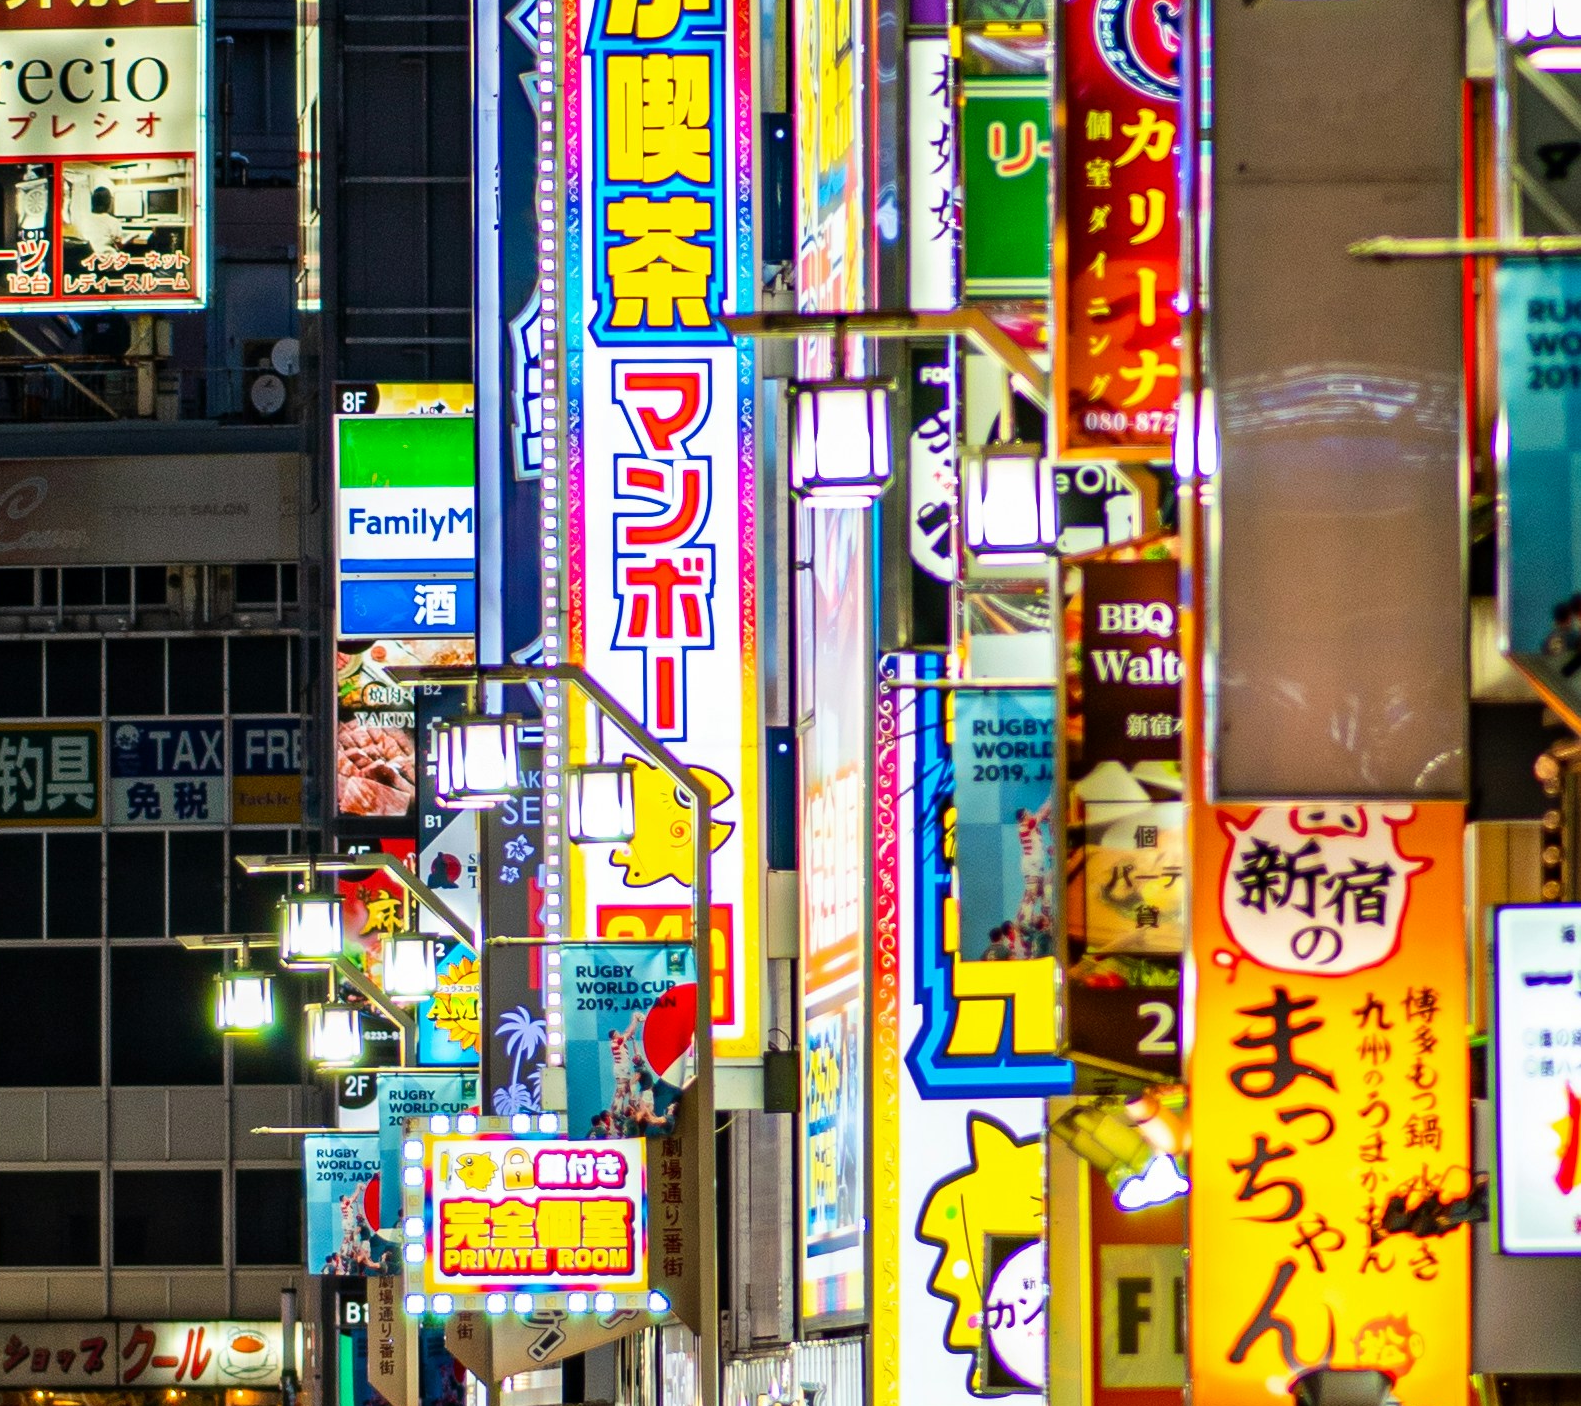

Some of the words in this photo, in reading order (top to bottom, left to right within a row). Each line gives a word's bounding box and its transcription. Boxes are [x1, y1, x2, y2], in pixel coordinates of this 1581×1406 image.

[81, 251, 192, 271] インターネット
[1084, 109, 1114, 403] 個室ダイニング
[1115, 106, 1179, 408] カリーナ
[6, 273, 51, 295] 12台
[63, 272, 191, 294] レディースルーム
[341, 391, 368, 413] 8F
[615, 365, 710, 738] マンボー
[413, 583, 458, 626] 酒
[1098, 602, 1173, 637] BBQ
[423, 683, 443, 696] B2
[149, 729, 223, 772] TAX
[126, 782, 210, 822] 免税
[424, 814, 443, 829] B1
[1233, 835, 1398, 929] 新宿
[1290, 924, 1344, 967] の
[575, 965, 635, 979] RUGBY
[575, 981, 639, 995] WORLD
[641, 979, 677, 995] CUP
[576, 997, 619, 1013] 2019,
[620, 996, 677, 1011] JAPAN
[1401, 986, 1443, 1153] 博多もつ鍋
[344, 1075, 370, 1097] 2F
[388, 1089, 435, 1101] RUGBY
[388, 1102, 438, 1114] WORLD
[316, 1148, 360, 1158] RUGBY
[316, 1160, 362, 1171] WORLD
[1226, 983, 1346, 1368] まっちゃん
[315, 1172, 348, 1184] 2019,
[443, 1199, 630, 1250] 完全個室
[443, 1248, 548, 1270] PRIVATE
[556, 1248, 628, 1270] ROOM
[122, 1324, 213, 1383] クール
